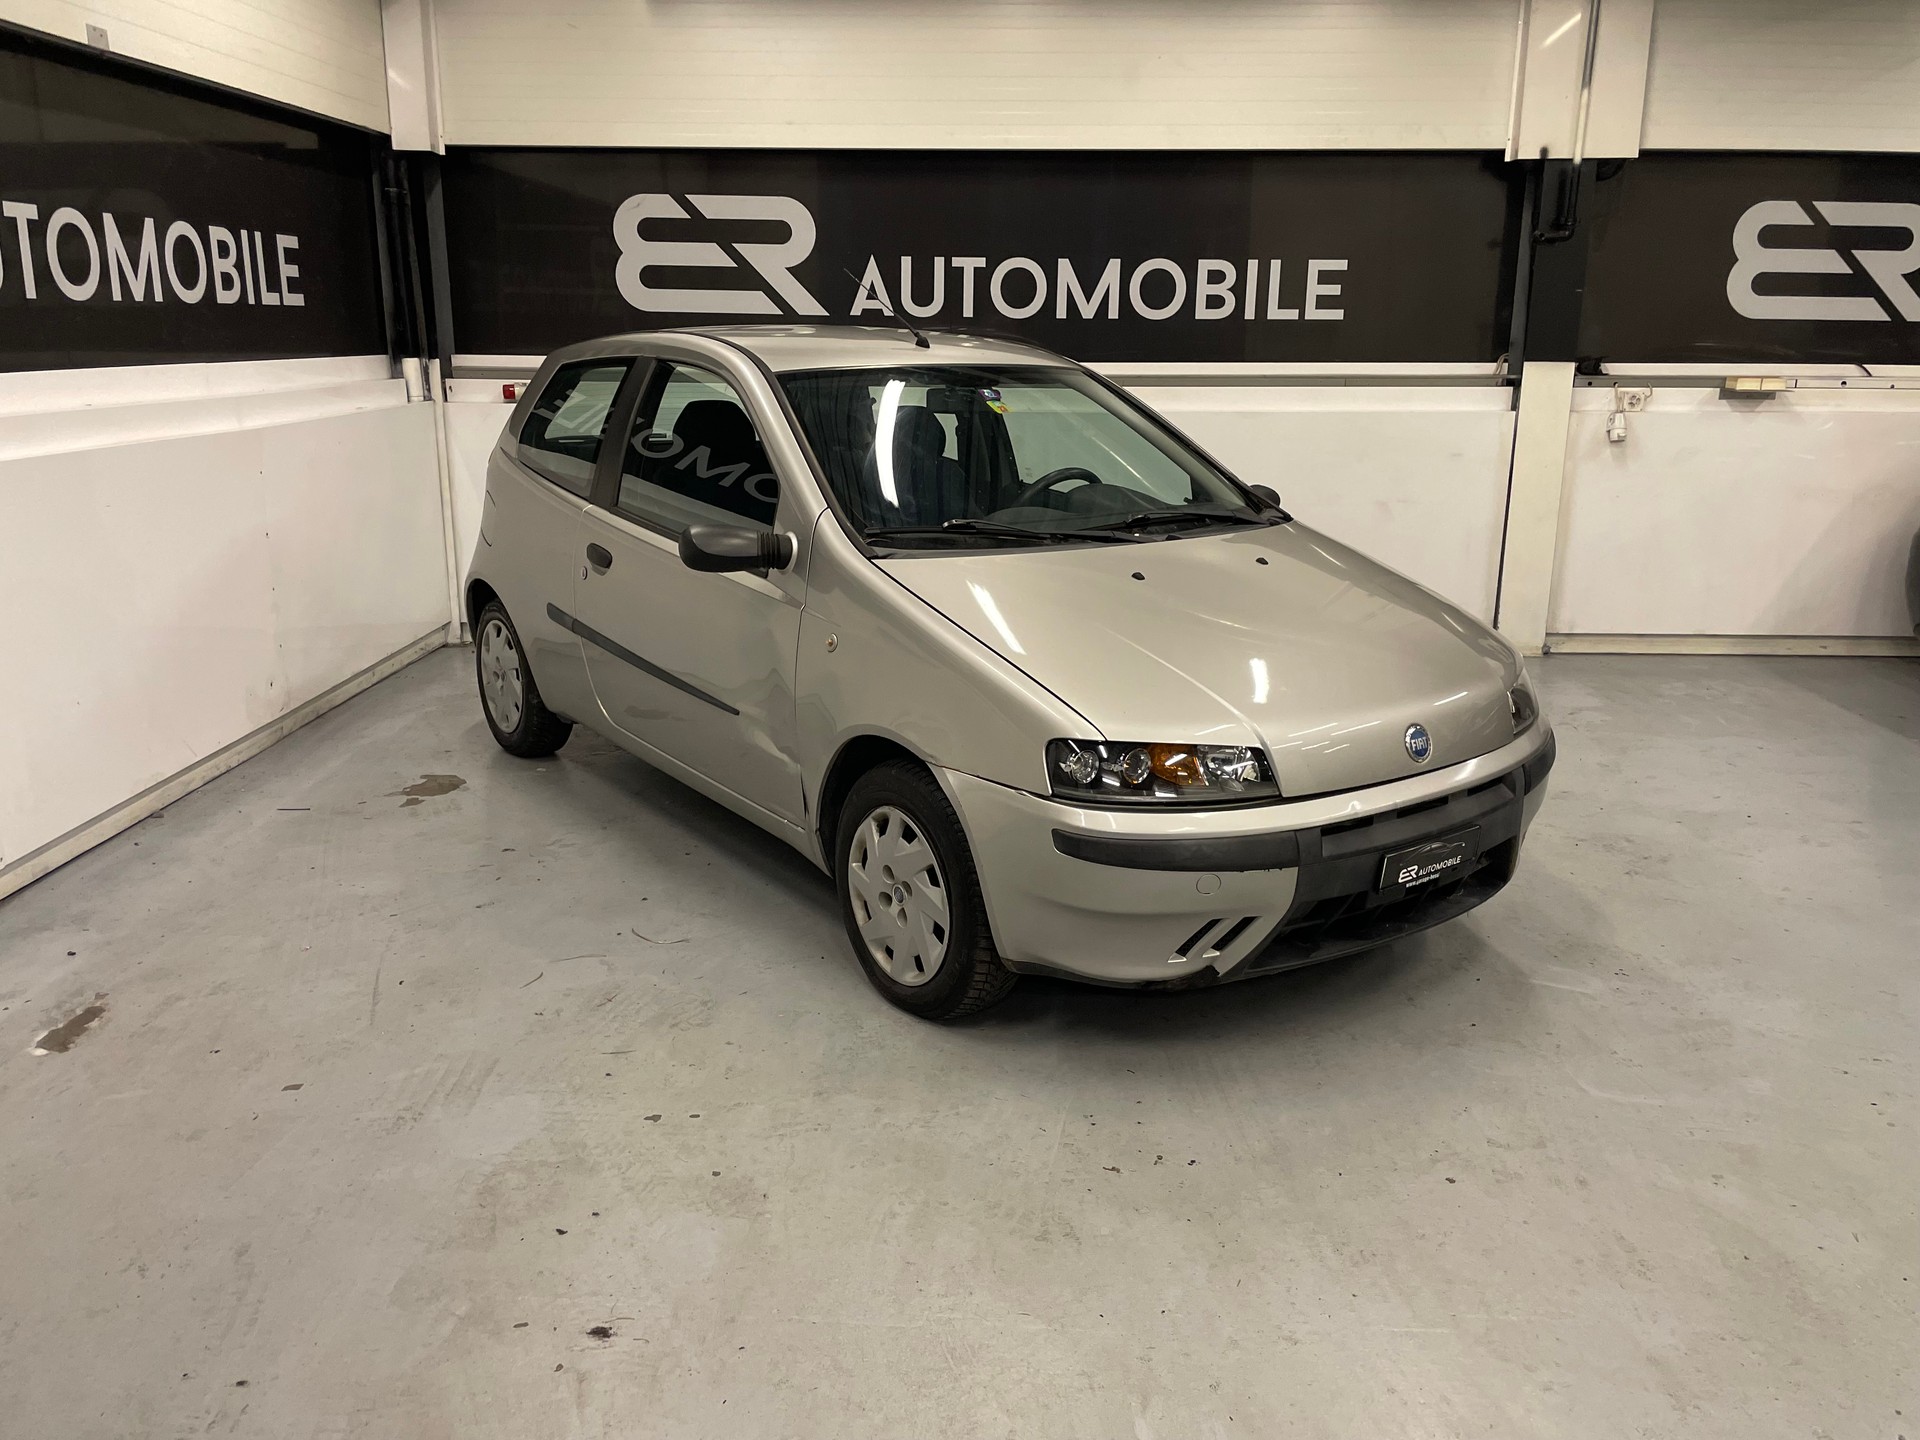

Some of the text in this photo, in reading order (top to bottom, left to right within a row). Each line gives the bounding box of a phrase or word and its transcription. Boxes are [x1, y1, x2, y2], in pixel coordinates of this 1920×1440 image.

[0, 200, 306, 306] TOMOBILE
[612, 193, 1349, 321] ER AUTOMOBILE
[1410, 736, 1428, 752] FIAT
[1398, 855, 1462, 883] ER AUTOMOBILE
